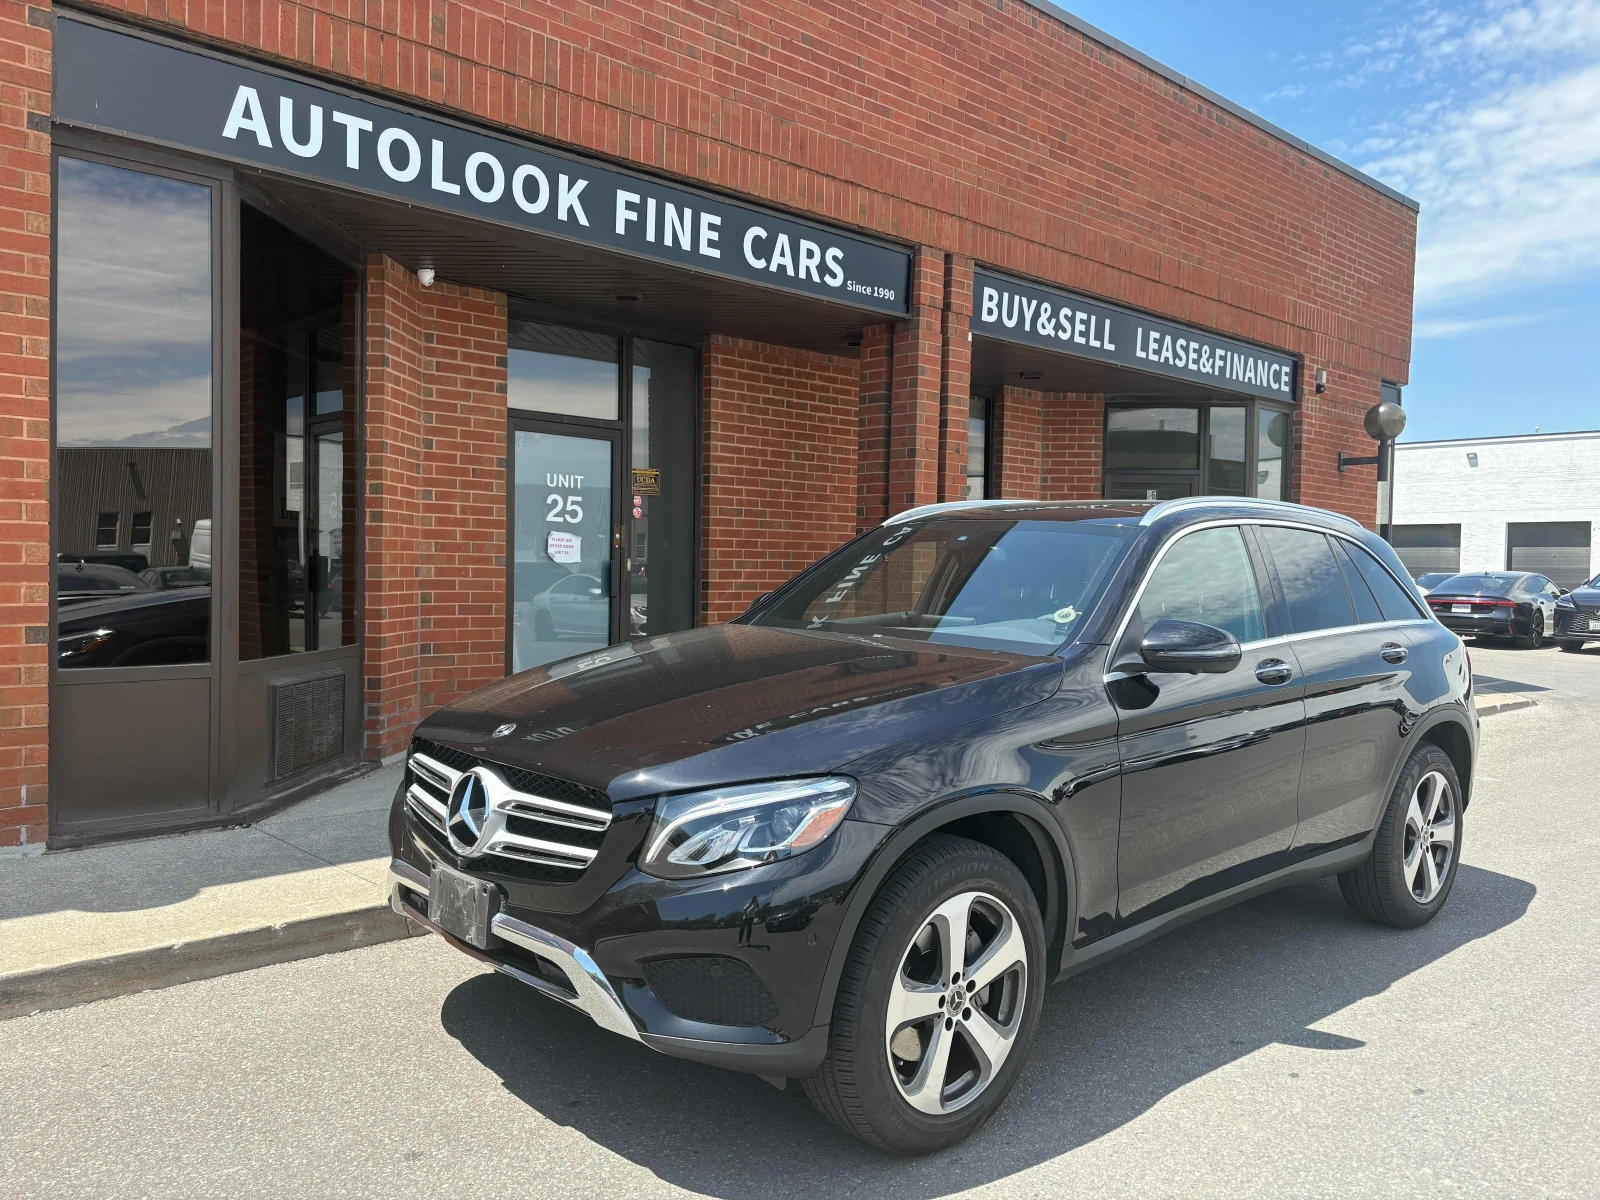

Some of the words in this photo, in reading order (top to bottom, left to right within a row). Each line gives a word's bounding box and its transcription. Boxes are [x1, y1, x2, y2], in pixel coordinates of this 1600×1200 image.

[221, 84, 590, 227] AUTOLOOK
[615, 188, 722, 259] FINE
[743, 226, 844, 287] CARS
[846, 280, 872, 296] Since
[873, 286, 895, 301] 1990
[981, 286, 1116, 352] BUY&SELL
[1135, 327, 1290, 392] LEASE&FINANCE
[546, 472, 585, 490] UNIT
[636, 476, 656, 484] UCDA
[545, 493, 584, 524] 25
